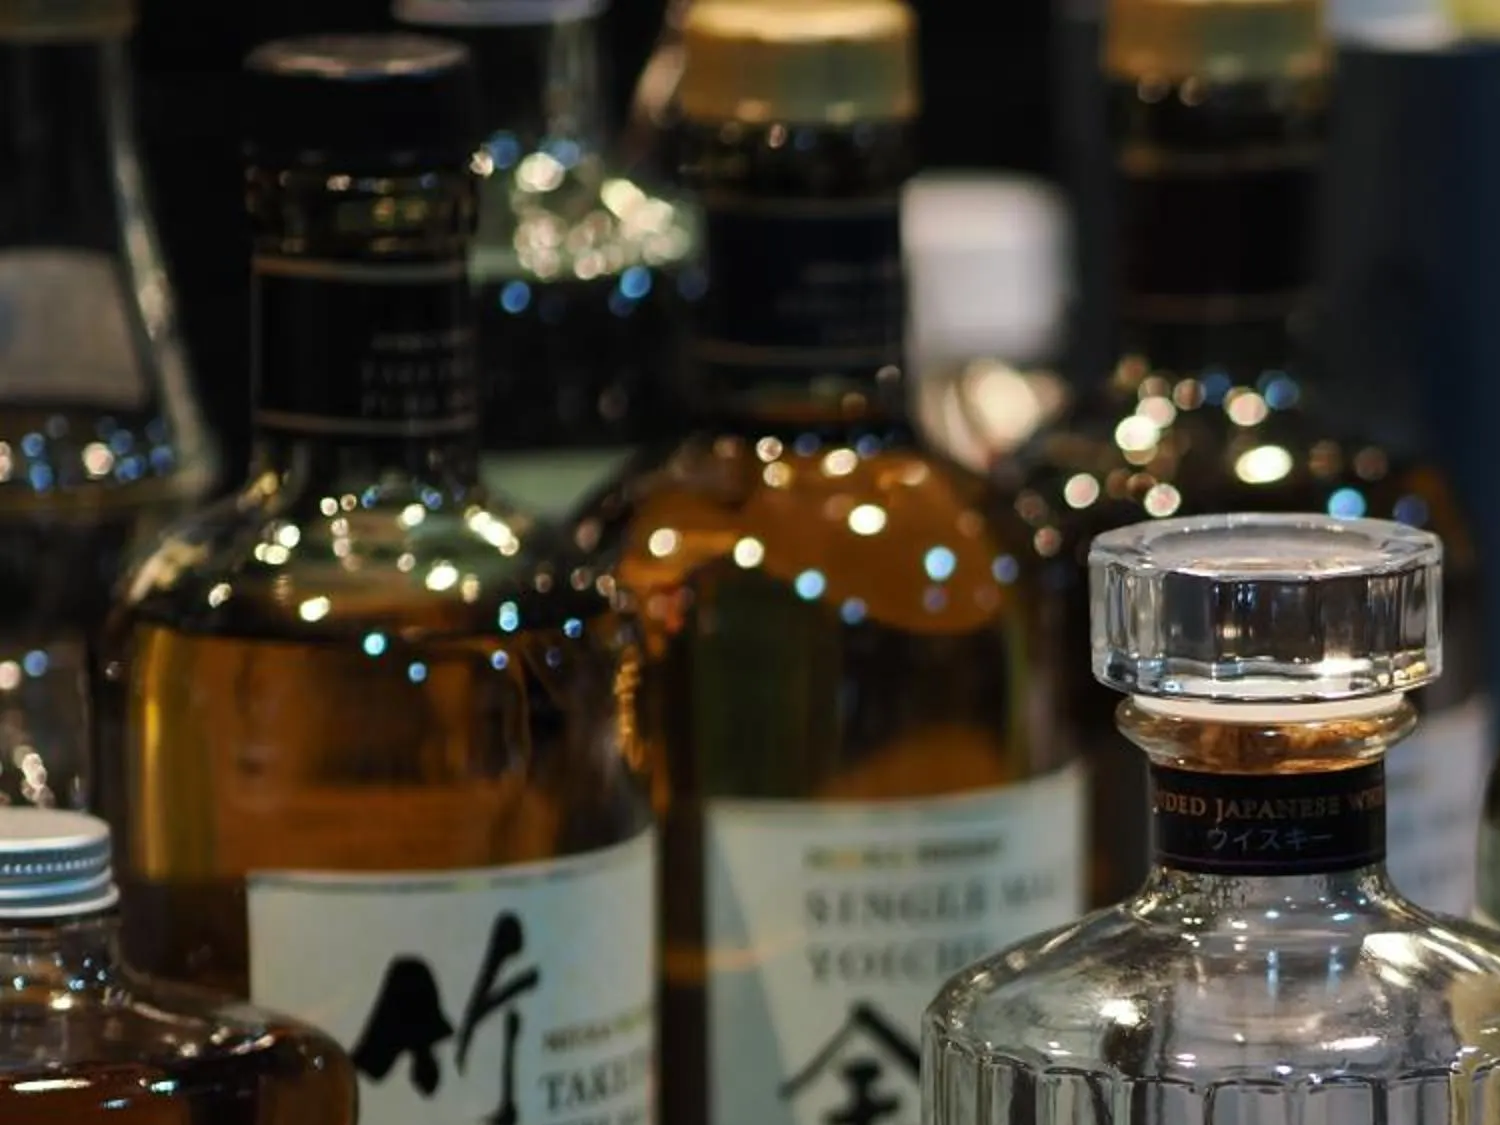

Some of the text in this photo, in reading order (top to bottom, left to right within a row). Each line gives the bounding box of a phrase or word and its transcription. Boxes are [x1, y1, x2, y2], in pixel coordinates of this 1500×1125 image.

[1215, 795, 1340, 824] JAPANESE
[1207, 828, 1333, 853] ウイスキー
